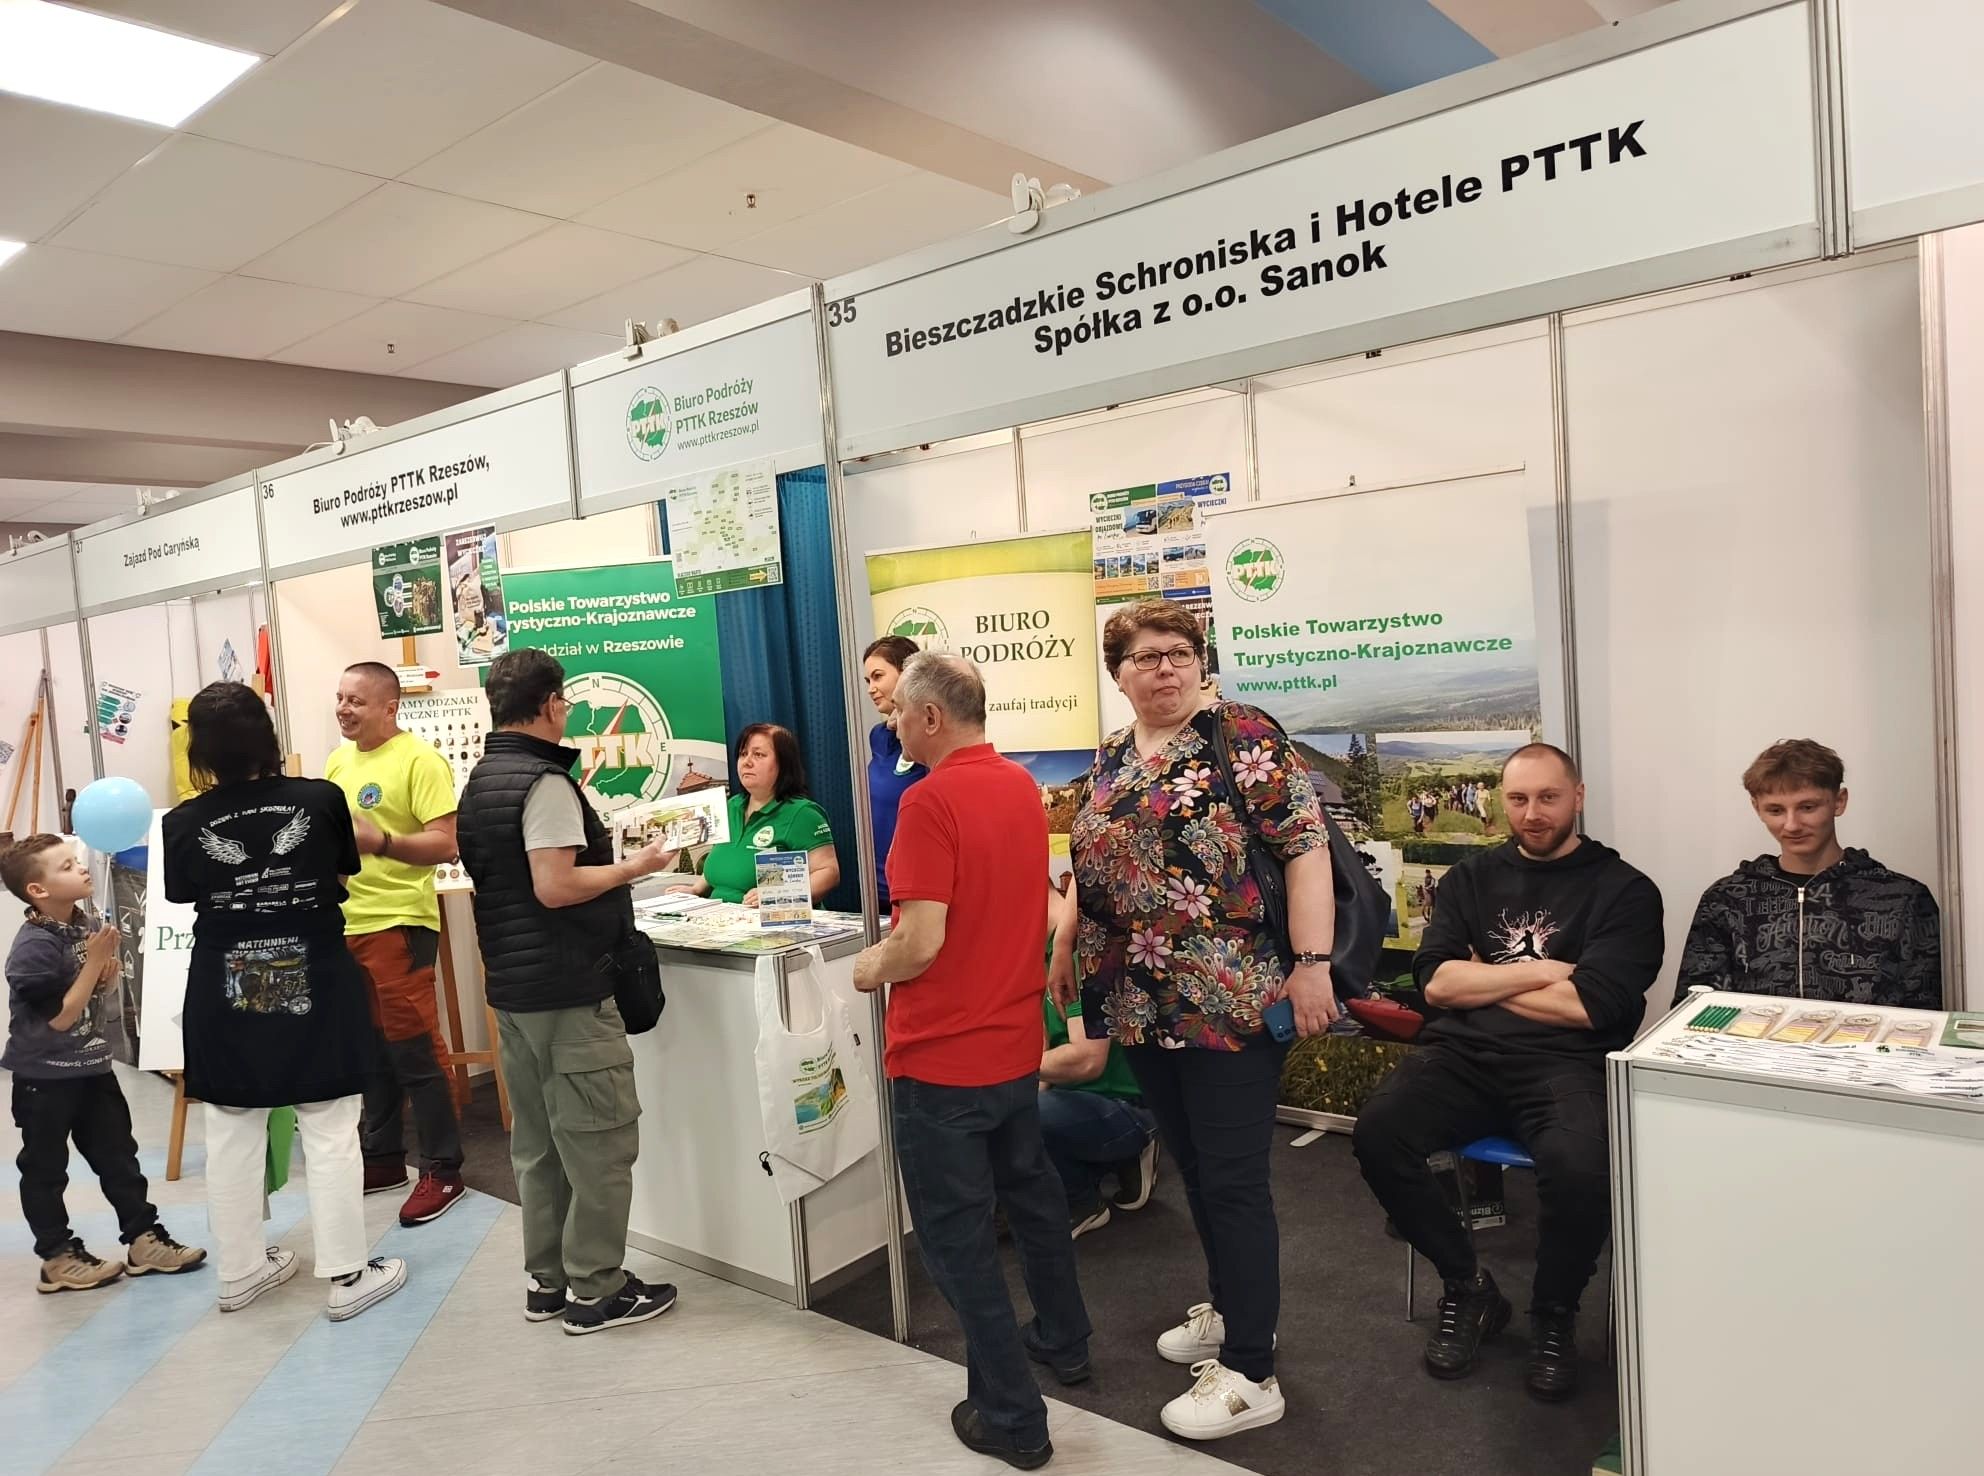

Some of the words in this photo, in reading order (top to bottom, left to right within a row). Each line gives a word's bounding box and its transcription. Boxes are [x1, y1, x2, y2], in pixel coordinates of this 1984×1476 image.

[885, 284, 1084, 357] Bieszczadzkie
[1095, 227, 1296, 301] Schroniska
[1310, 212, 1320, 243] i
[1336, 174, 1483, 236] Hotele
[1500, 119, 1648, 193] PTTK
[1034, 301, 1142, 356] Spółka
[1153, 299, 1171, 324] z
[1182, 283, 1247, 317] o.o.
[1260, 240, 1388, 297] Sanok
[828, 298, 857, 328] 35
[674, 393, 704, 411] Biuro
[706, 378, 754, 403] Podróży
[676, 414, 707, 434] PTTK
[709, 401, 759, 425] Rzeszów
[677, 420, 760, 451] www.pttkrzeszow.pl
[263, 483, 274, 500] 36
[313, 499, 341, 514] Biuro
[343, 481, 387, 506] Podróży
[391, 468, 426, 493] PTTK
[429, 453, 490, 483] Rzeszów,
[341, 483, 459, 528] www.pttkrzeszow.pl
[1197, 498, 1227, 508] WYCIECZKI
[76, 541, 83, 554] 37
[123, 549, 147, 568] Zajazd
[148, 545, 162, 560] Pod
[163, 536, 201, 556] Caryńską
[509, 598, 565, 614] Polskie
[567, 591, 671, 611] Towarzystwo
[507, 605, 696, 633] rystyczno-Krajoznawcze
[975, 610, 1050, 634] BIURO
[1231, 621, 1300, 641] Polskie
[1305, 611, 1443, 635] Towarzystwo
[528, 641, 582, 657] ddział
[585, 643, 599, 653] w
[603, 635, 684, 653] Rzeszowie
[960, 634, 1076, 664] PODRÓŻY
[1234, 635, 1513, 668] Turystyczno-Krajoznawcze
[592, 678, 600, 688] N
[1236, 675, 1337, 693] www.pttk.pl
[398, 709, 440, 720] TYCZNE
[442, 707, 472, 717] PTTK
[400, 699, 425, 709] AMY
[427, 696, 478, 708] ODZNAKI
[989, 697, 1026, 714] zaufaj
[1030, 695, 1079, 714] tradycji
[560, 732, 655, 771] TTK
[660, 742, 666, 752] E
[603, 812, 610, 821] S
[156, 926, 195, 951] Prz
